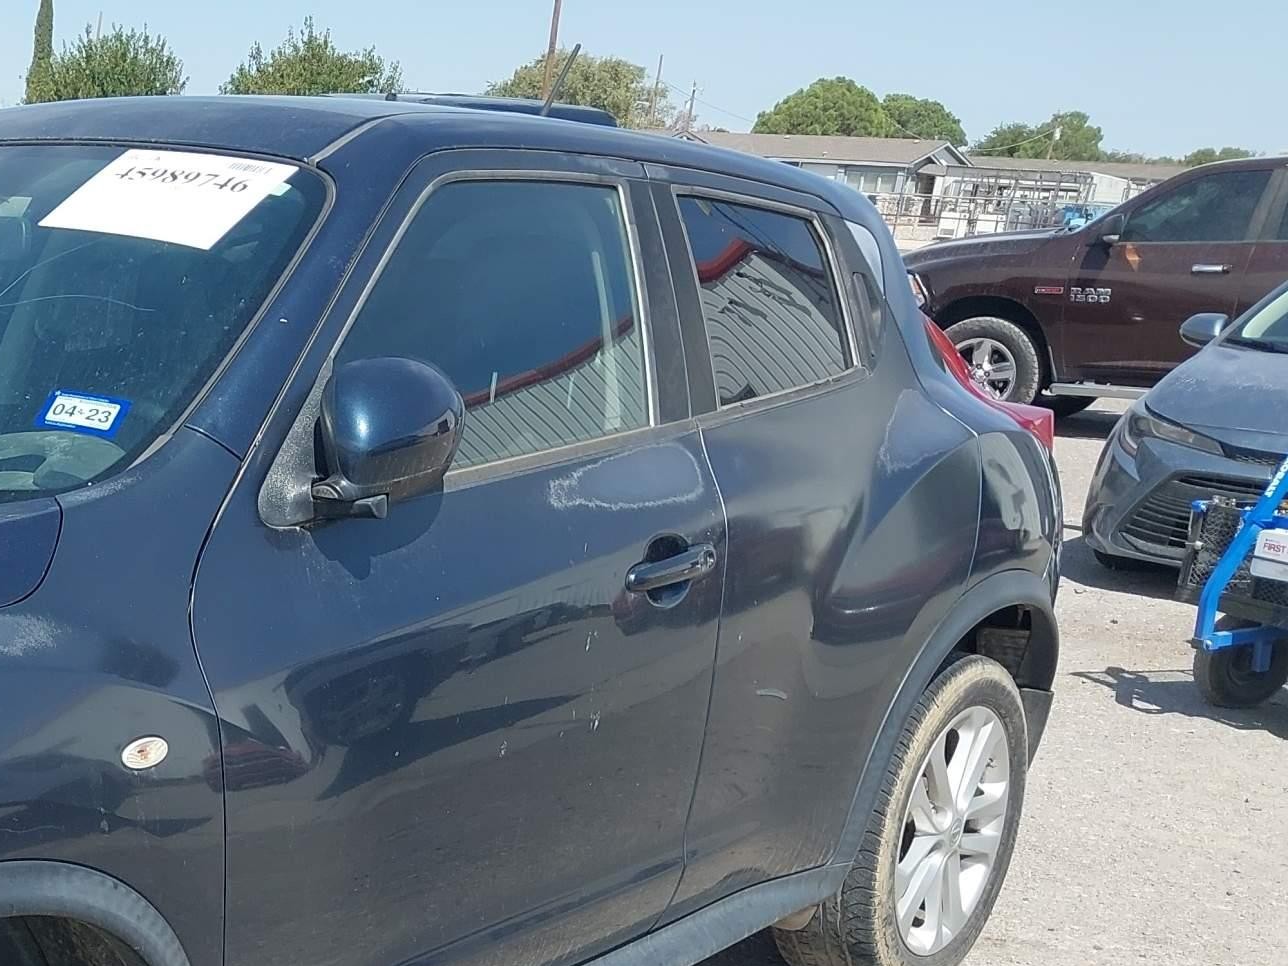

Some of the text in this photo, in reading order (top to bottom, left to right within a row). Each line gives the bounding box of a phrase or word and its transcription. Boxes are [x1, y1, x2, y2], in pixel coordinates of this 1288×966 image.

[115, 166, 249, 193] 45989746
[1071, 287, 1112, 296] RAM
[1070, 294, 1110, 303] 1500
[52, 403, 77, 417] 04
[85, 408, 112, 423] 23
[1263, 542, 1287, 553] FIRST
